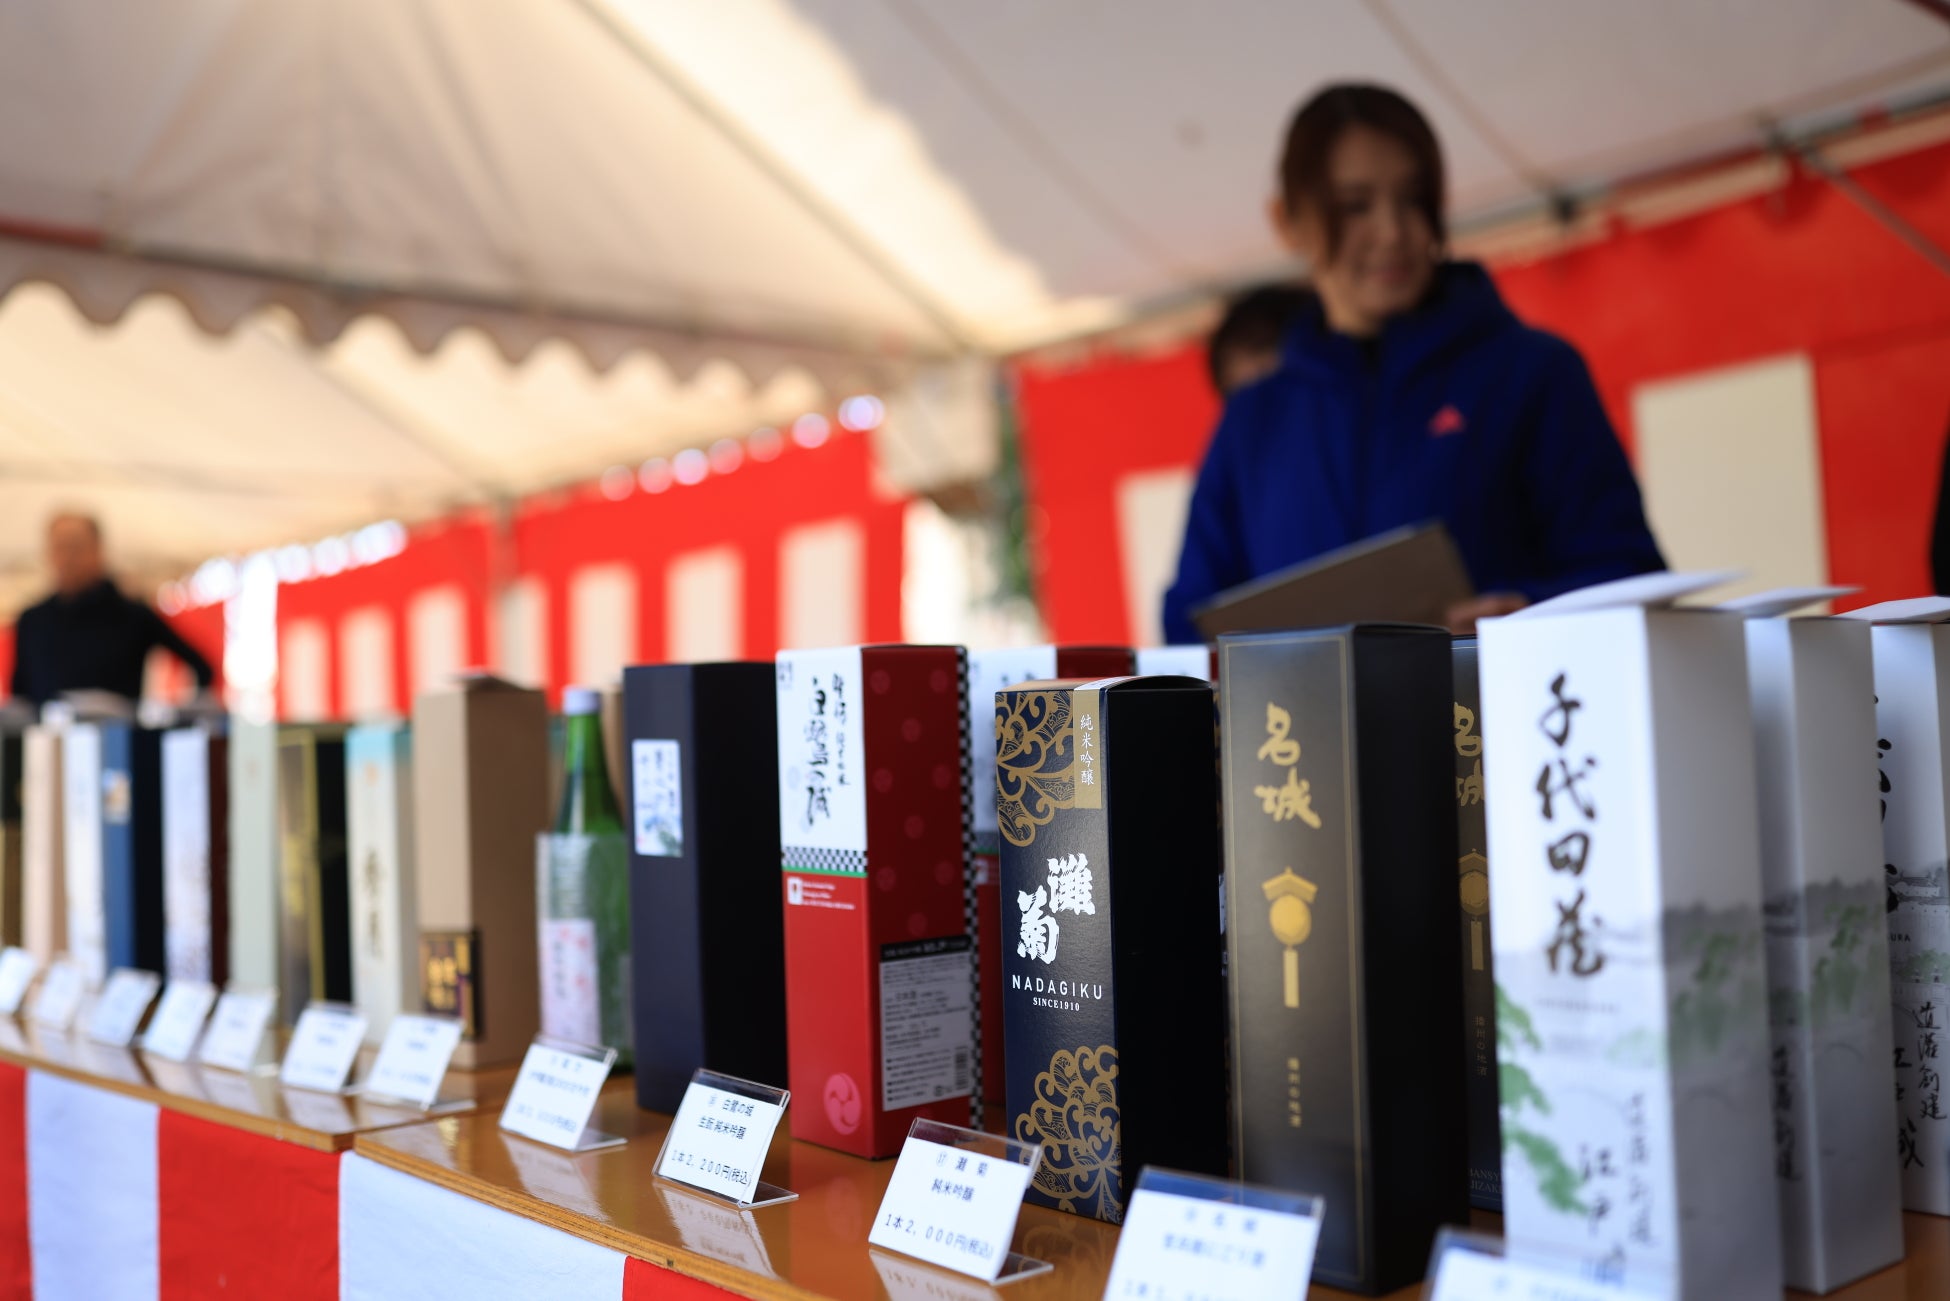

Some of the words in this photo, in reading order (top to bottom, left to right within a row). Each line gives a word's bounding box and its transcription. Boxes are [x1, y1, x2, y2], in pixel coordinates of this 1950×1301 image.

[1079, 713, 1095, 786] 純米吟醸
[1254, 702, 1321, 829] 名城
[1016, 852, 1096, 965] 灘菊
[1012, 974, 1103, 1000] NADAGIKU
[1032, 997, 1081, 1012] SINCE1910
